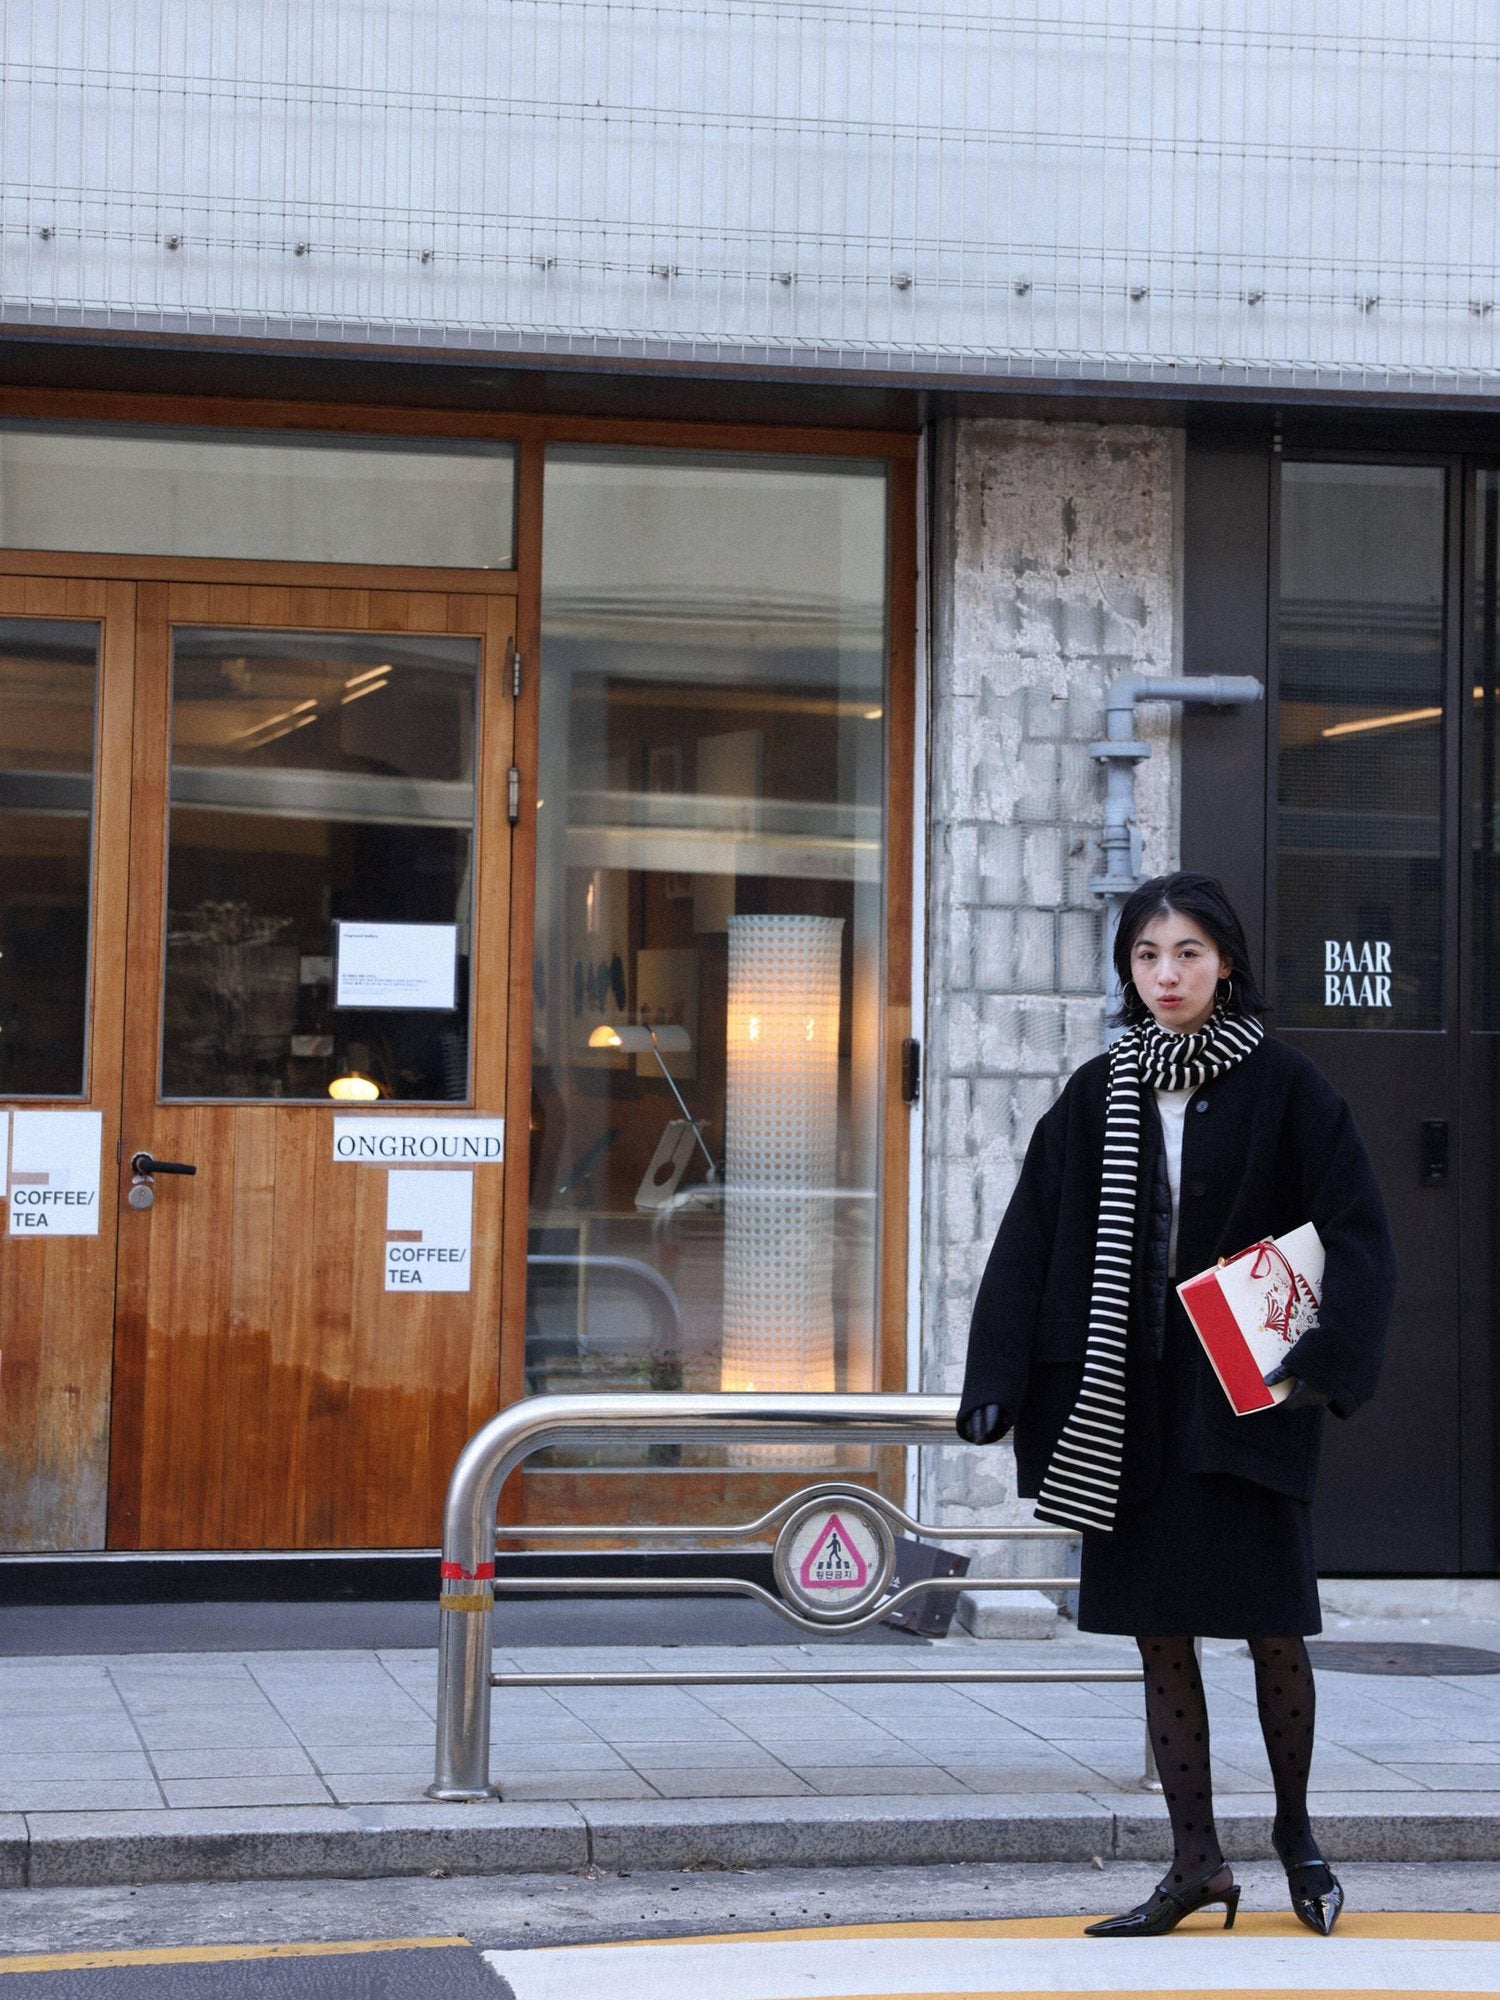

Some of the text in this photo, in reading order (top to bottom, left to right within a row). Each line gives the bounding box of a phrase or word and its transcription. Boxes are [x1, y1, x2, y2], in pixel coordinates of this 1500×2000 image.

[1324, 940, 1392, 973] BAAR
[1324, 974, 1392, 1007] BAAR
[337, 1135, 501, 1157] ONGROUND
[13, 1190, 95, 1206] COFFEE/
[12, 1212, 49, 1227] TEA
[388, 1248, 466, 1262] COFFEE/
[388, 1269, 423, 1283] TEA
[816, 1570, 852, 1580] 횡단금지
